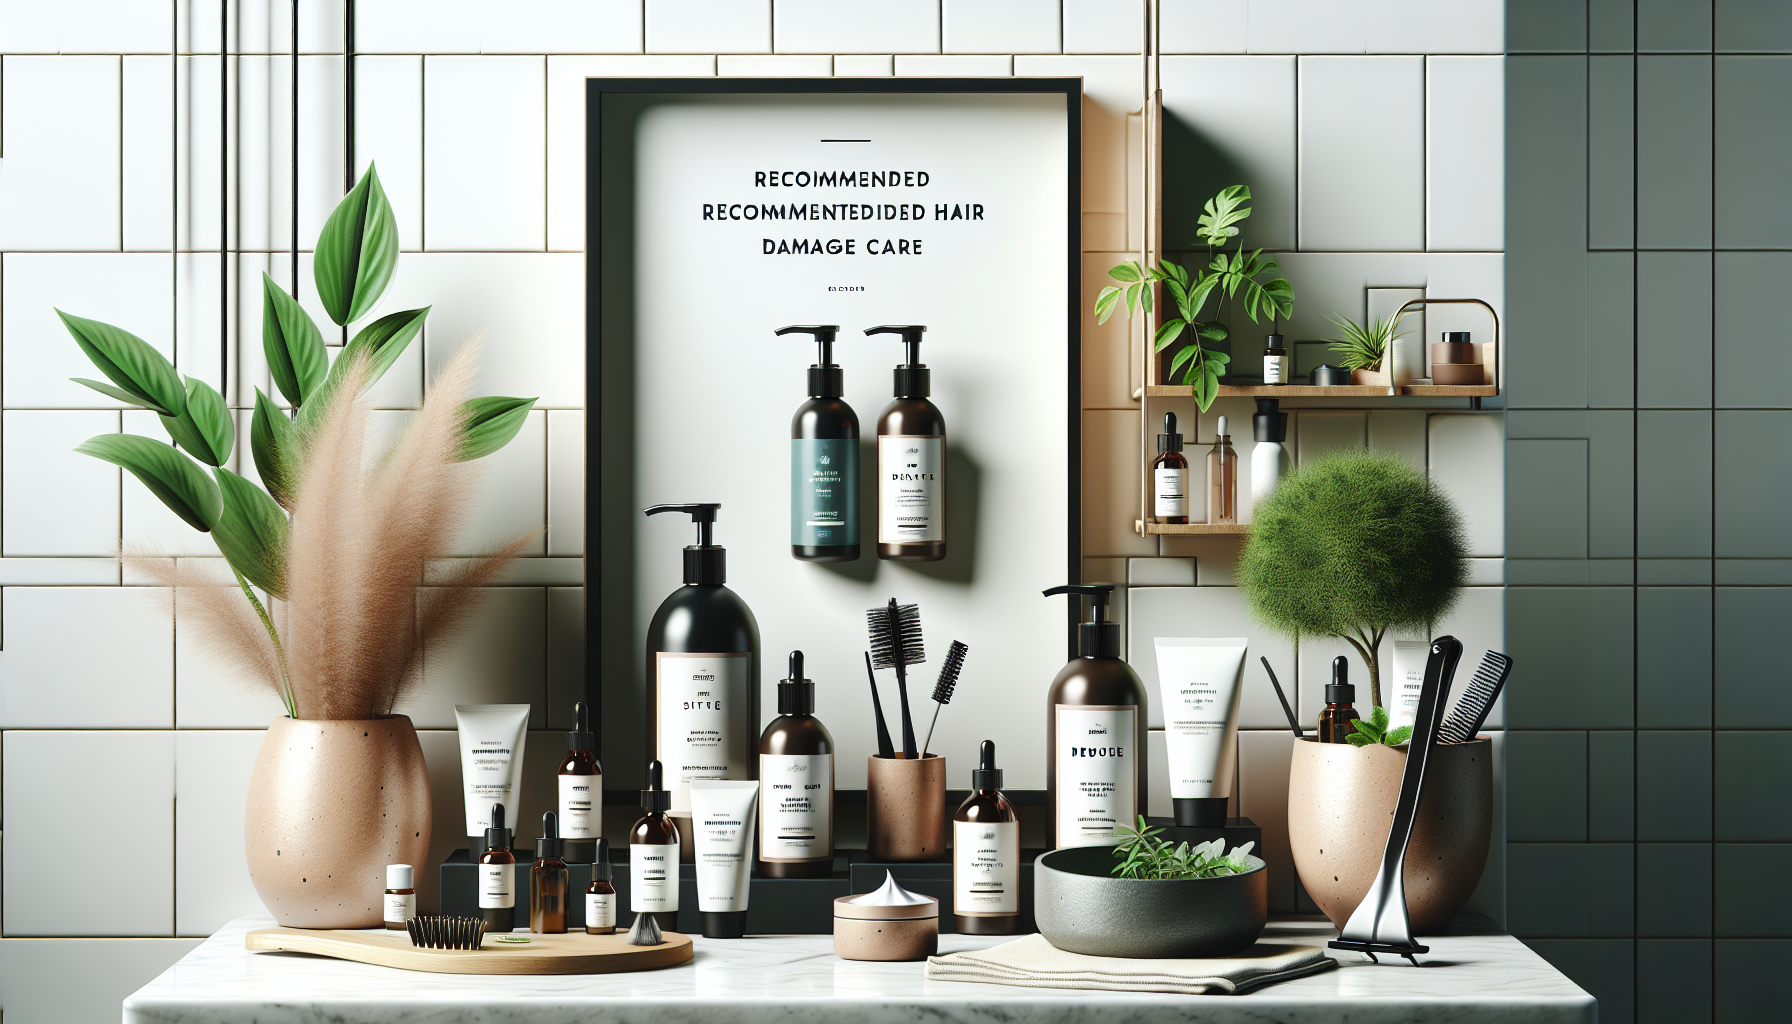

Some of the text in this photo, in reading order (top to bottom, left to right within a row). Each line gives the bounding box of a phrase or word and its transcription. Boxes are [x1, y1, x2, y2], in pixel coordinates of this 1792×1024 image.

[934, 203, 985, 221] HAIR
[762, 238, 923, 256] DAMAGE CARE
